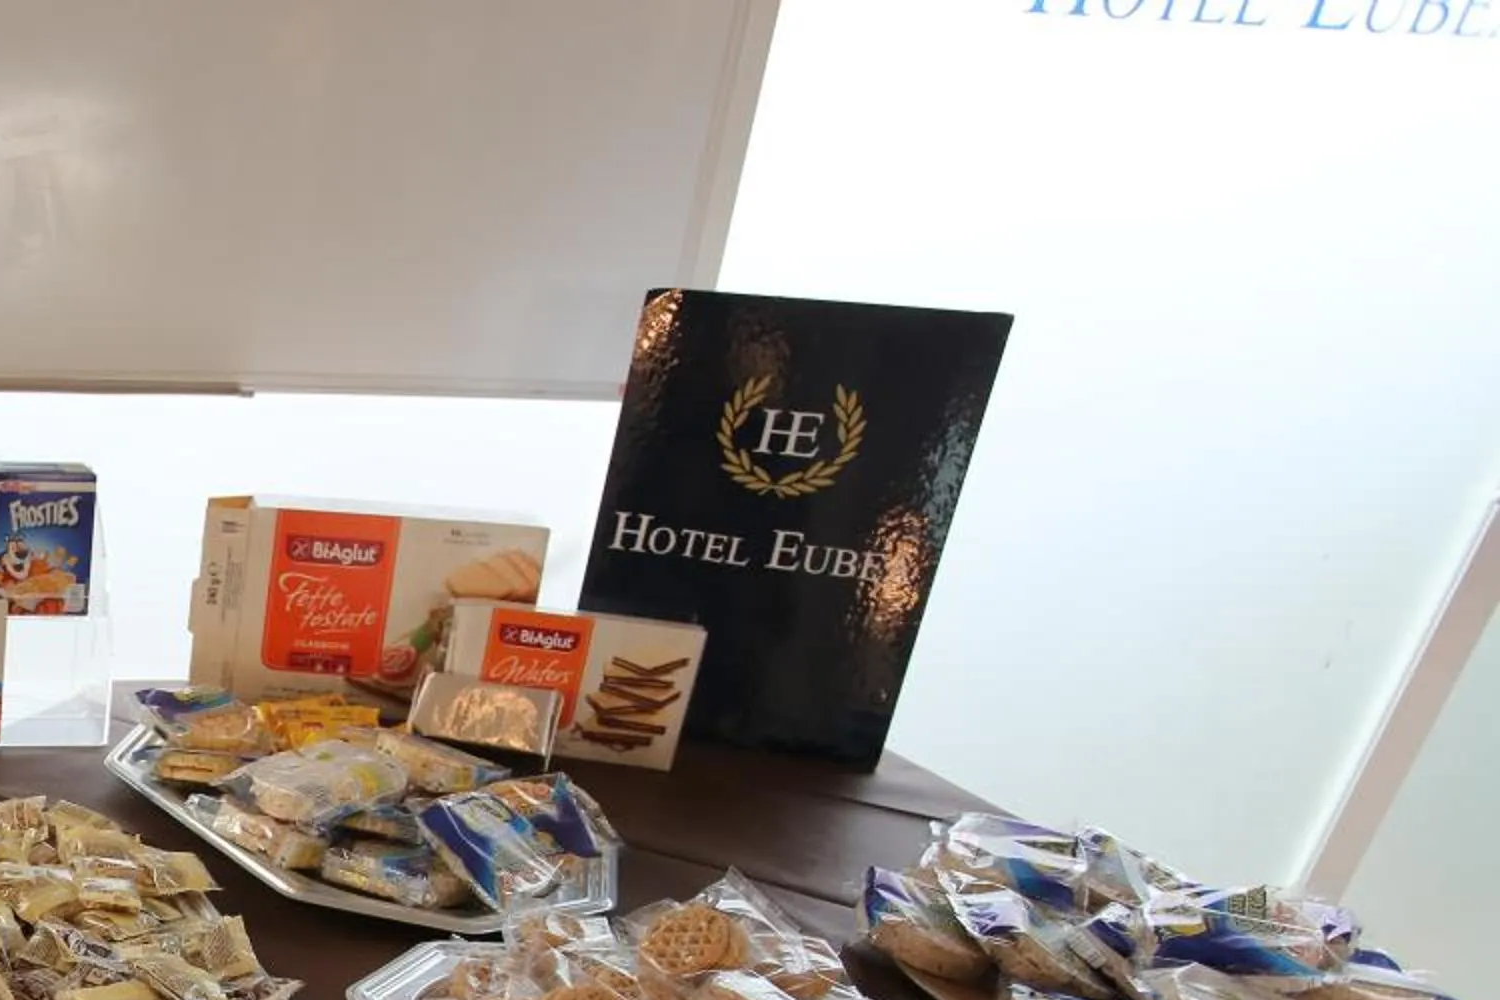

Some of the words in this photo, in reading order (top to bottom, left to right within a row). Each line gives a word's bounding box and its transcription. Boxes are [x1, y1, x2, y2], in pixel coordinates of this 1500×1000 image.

[751, 408, 826, 459] HE
[9, 496, 81, 533] FROSTIES
[608, 511, 750, 567] HOTEL
[764, 529, 920, 588] EUBE
